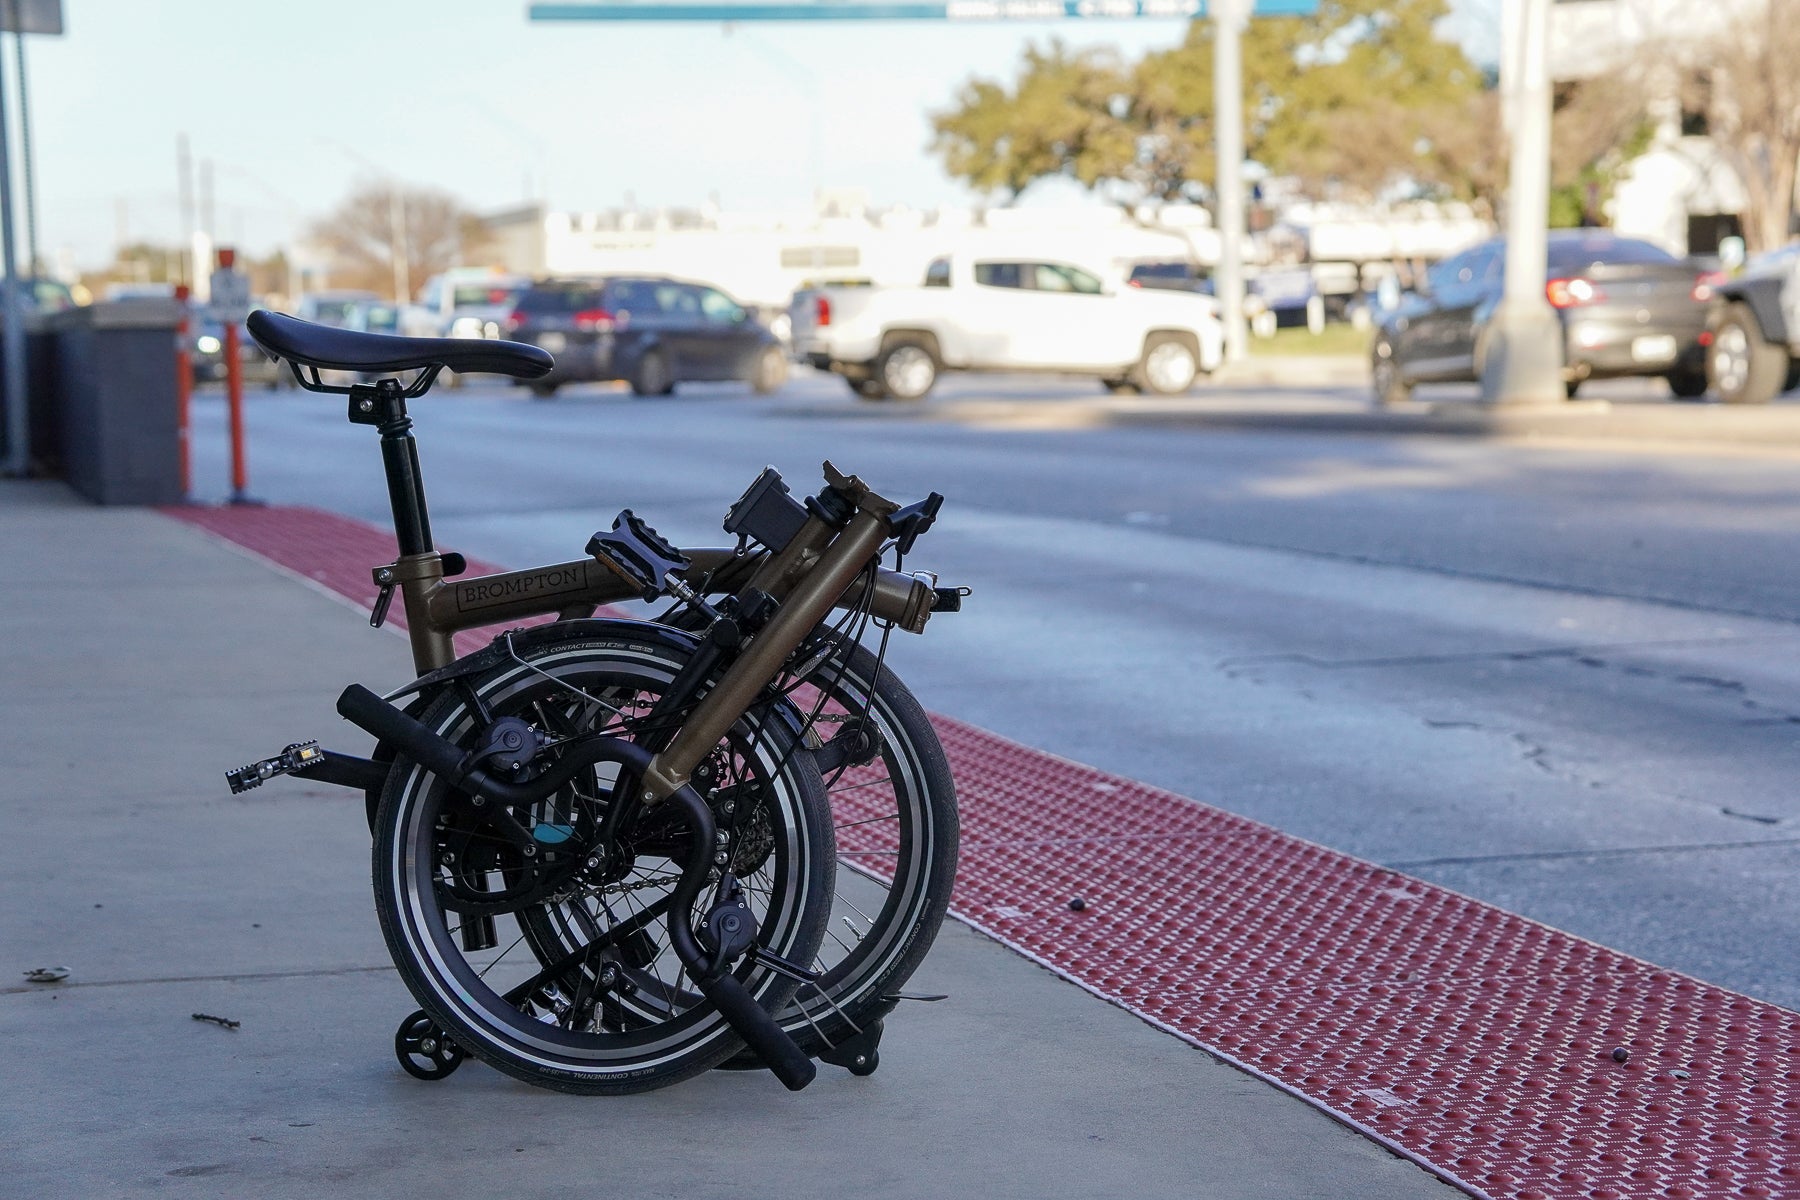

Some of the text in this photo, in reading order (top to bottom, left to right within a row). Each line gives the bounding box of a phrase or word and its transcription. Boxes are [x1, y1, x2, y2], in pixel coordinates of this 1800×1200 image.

[464, 568, 577, 603] BROMPTON
[550, 642, 587, 653] CONTACT
[573, 1072, 629, 1080] CONTINENTAL
